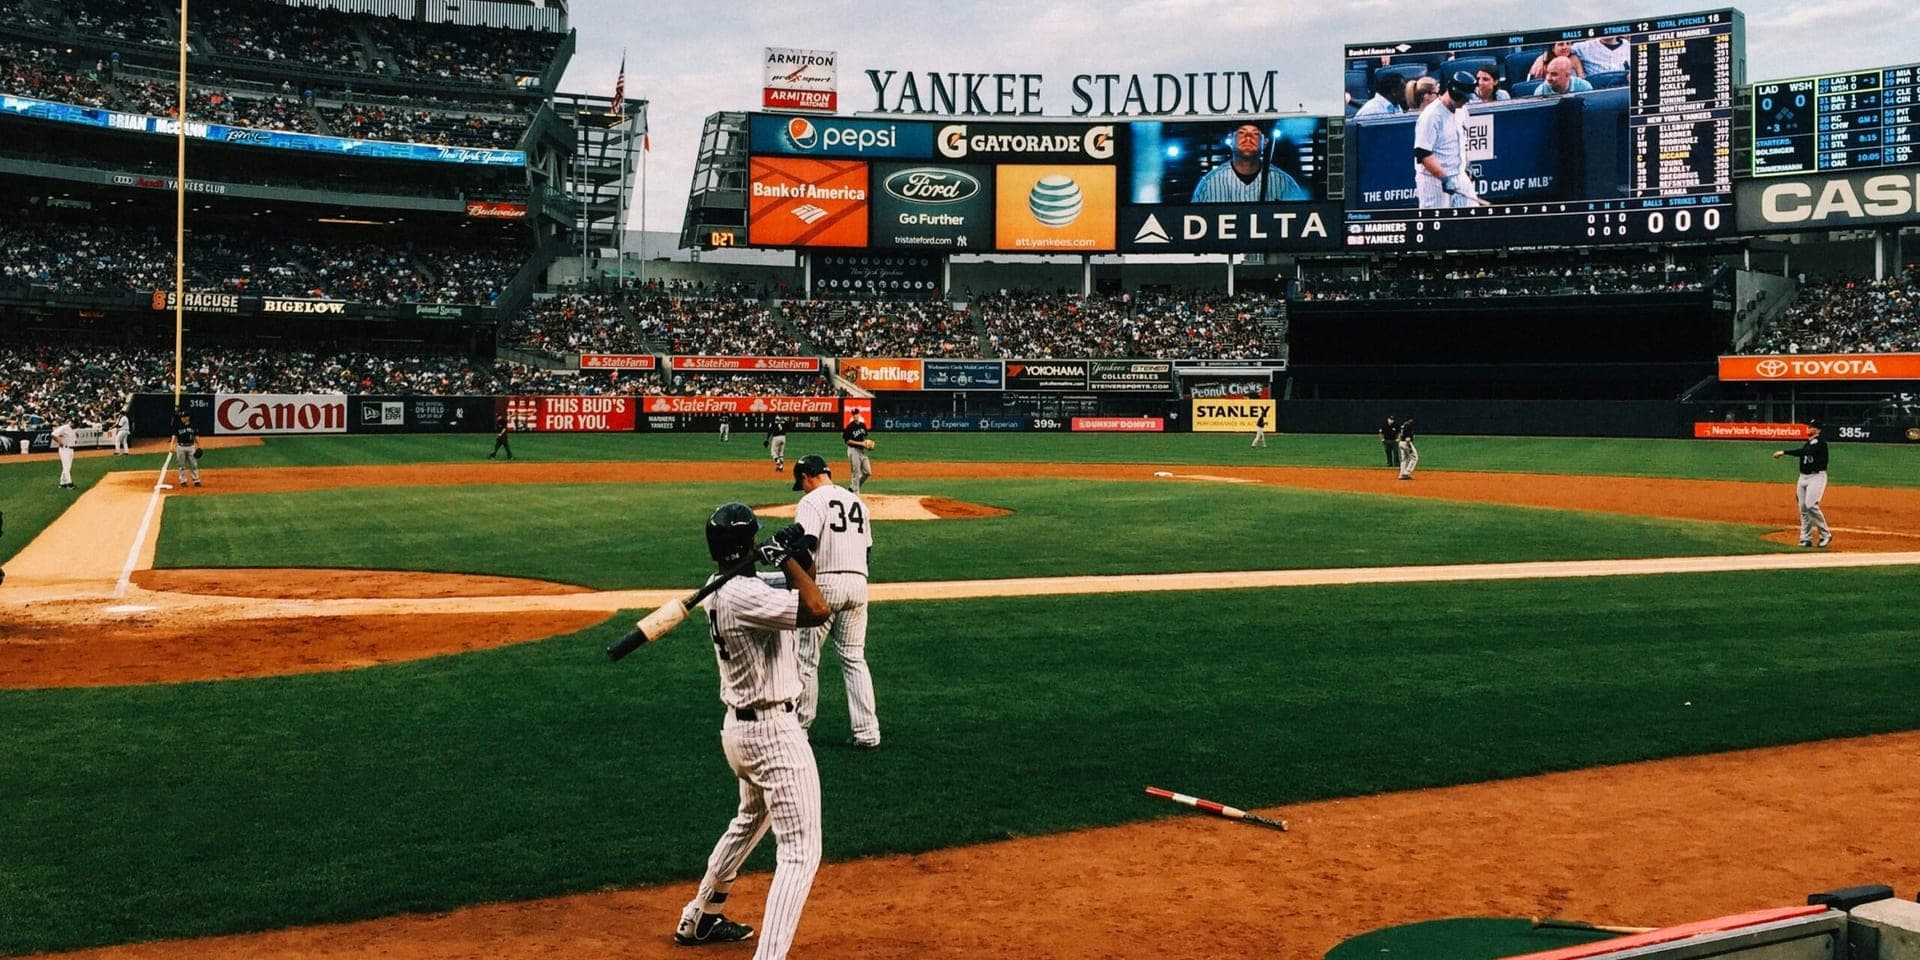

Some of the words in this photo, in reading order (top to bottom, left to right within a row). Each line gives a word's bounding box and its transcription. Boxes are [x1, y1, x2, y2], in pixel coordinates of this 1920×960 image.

[1708, 14, 1720, 23] 18
[1562, 30, 1582, 39] BALLS
[1588, 29, 1594, 37] 6
[1604, 26, 1631, 34] STRIKES
[1638, 22, 1648, 31] 12
[1468, 40, 1488, 48] SPEED
[768, 54, 834, 66] ARMITRON
[865, 70, 1043, 116] YANKEE
[1071, 70, 1278, 116] STADIUM
[1760, 86, 1778, 95] LAD
[1790, 82, 1812, 92] WSH
[771, 91, 830, 102] ARMITRON
[1762, 98, 1772, 111] 0
[1795, 94, 1806, 108] 0
[108, 114, 147, 132] BRIAN
[824, 125, 896, 151] pepsi
[970, 135, 1080, 152] GATORADE
[168, 180, 204, 192] YAKEES
[205, 184, 225, 194] CLUB
[753, 182, 788, 197] Bank
[791, 184, 806, 198] of
[806, 184, 864, 200] America
[902, 173, 960, 198] Ford
[1491, 180, 1510, 192] CAP
[1514, 178, 1525, 190] OF
[1364, 191, 1382, 203] THE
[1669, 197, 1696, 206] STRIKES
[1701, 196, 1720, 204] OUTS
[1761, 172, 1920, 223] CAS
[468, 206, 526, 218] Budweiser
[900, 214, 916, 224] Go
[919, 214, 964, 225] Further
[1183, 212, 1328, 241] DELTA
[1364, 222, 1407, 232] MARINERS
[1416, 222, 1424, 231] 0
[1434, 222, 1440, 230] 0
[1588, 214, 1596, 224] 0
[1604, 214, 1610, 223] 1
[1618, 212, 1626, 222] 0
[1648, 212, 1664, 234] 0
[1675, 210, 1692, 232] 0
[1704, 208, 1720, 230] 0
[712, 233, 734, 246] 0:27
[895, 236, 952, 245] tristateford.com
[1365, 234, 1406, 244] YANKEES
[1416, 234, 1424, 244] 0
[1588, 226, 1596, 236] 0
[1604, 226, 1611, 236] 0
[1618, 225, 1626, 235] 0
[1016, 238, 1096, 248] att.yankees.com
[168, 292, 239, 308] SRACUSE
[861, 366, 920, 382] DraftKings
[1025, 366, 1084, 376] YOKOHAMA
[1092, 362, 1126, 376] Yankees
[1791, 360, 1878, 375] TOYOTA
[1190, 384, 1227, 398] Peanut
[1228, 382, 1262, 394] Chews
[546, 398, 578, 413] THIS
[582, 398, 625, 414] BUD'S
[1197, 406, 1271, 418] STANLEY
[218, 398, 344, 431] Canon
[546, 414, 574, 430] FOR
[578, 414, 610, 430] YOU.
[895, 420, 922, 429] Experian
[941, 420, 969, 429] Experian
[990, 420, 1018, 429] Experian
[34, 433, 50, 444] ACC
[829, 500, 864, 534] 34
